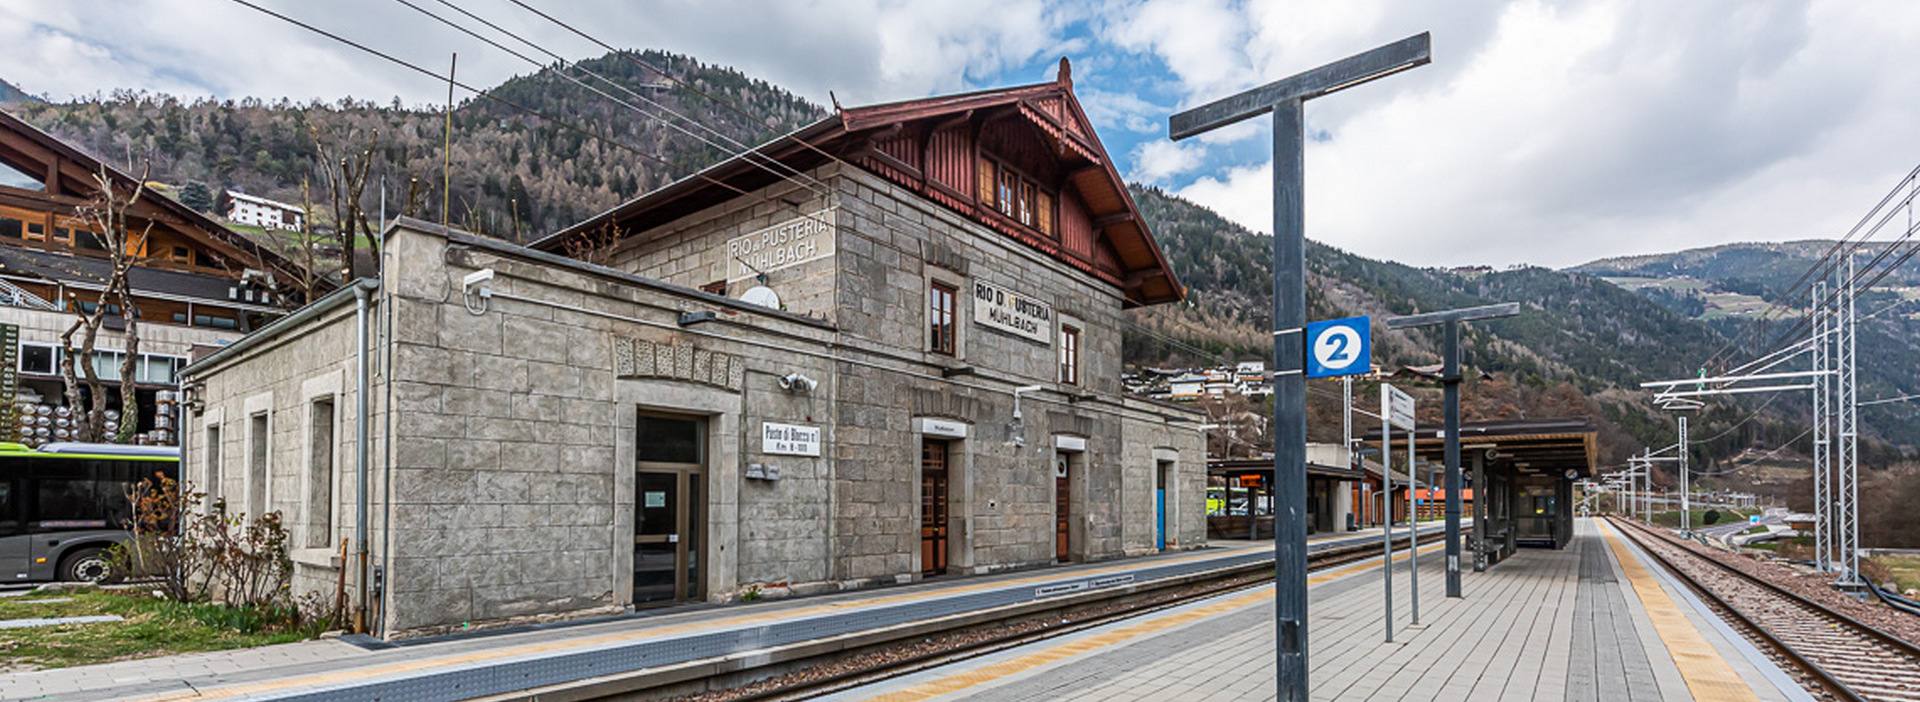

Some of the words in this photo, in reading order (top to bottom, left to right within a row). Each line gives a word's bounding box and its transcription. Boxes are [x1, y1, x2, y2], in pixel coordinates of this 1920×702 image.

[730, 238, 752, 258] RIO
[761, 215, 829, 249] PUSTERIA
[976, 283, 993, 303] RIO
[1325, 332, 1349, 361] 2
